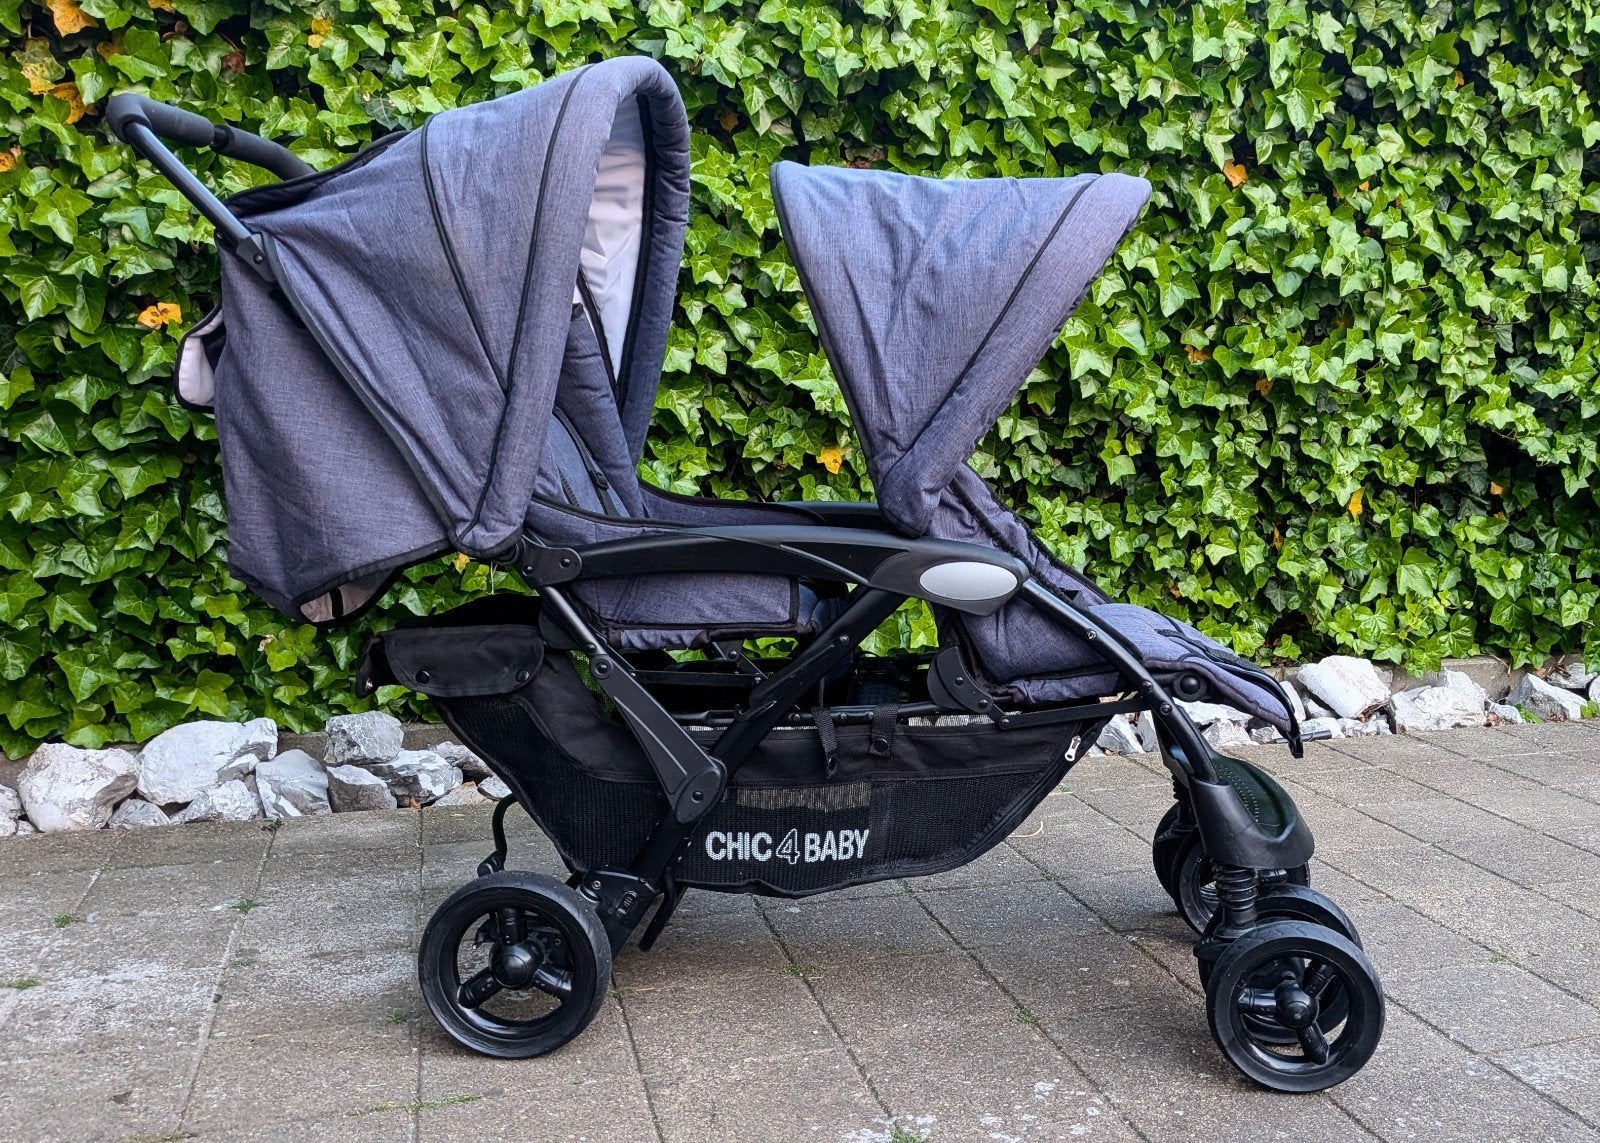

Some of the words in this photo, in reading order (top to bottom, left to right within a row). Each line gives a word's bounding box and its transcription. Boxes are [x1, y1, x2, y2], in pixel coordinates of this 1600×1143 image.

[705, 831, 772, 861] CHIC
[776, 828, 800, 865] 4
[804, 829, 869, 862] BABY
